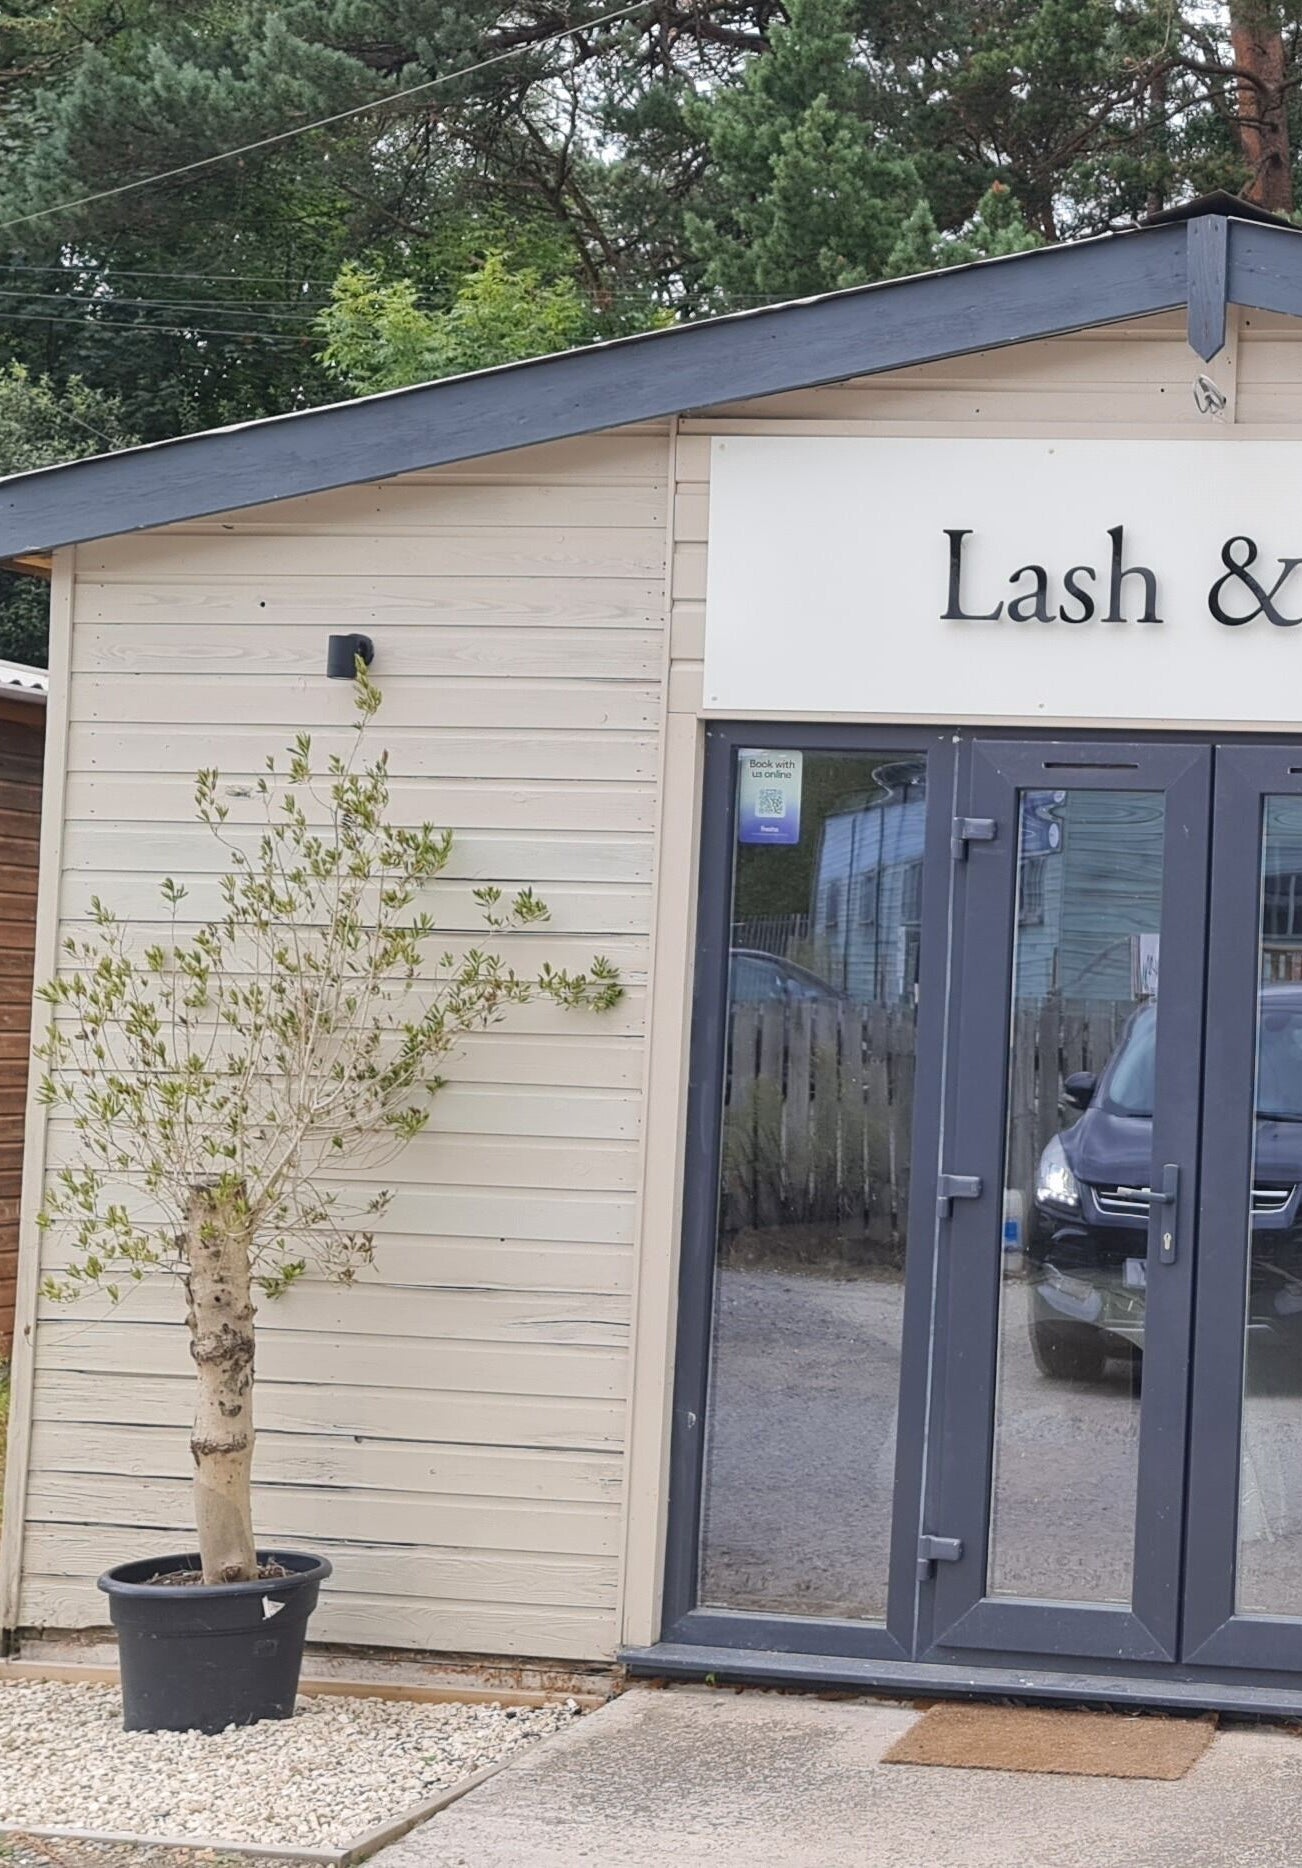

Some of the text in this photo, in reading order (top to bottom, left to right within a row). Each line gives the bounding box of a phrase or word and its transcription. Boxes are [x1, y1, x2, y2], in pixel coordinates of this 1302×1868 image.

[939, 524, 1164, 624] Lash
[749, 759, 795, 769] Book with
[764, 769, 792, 779] online
